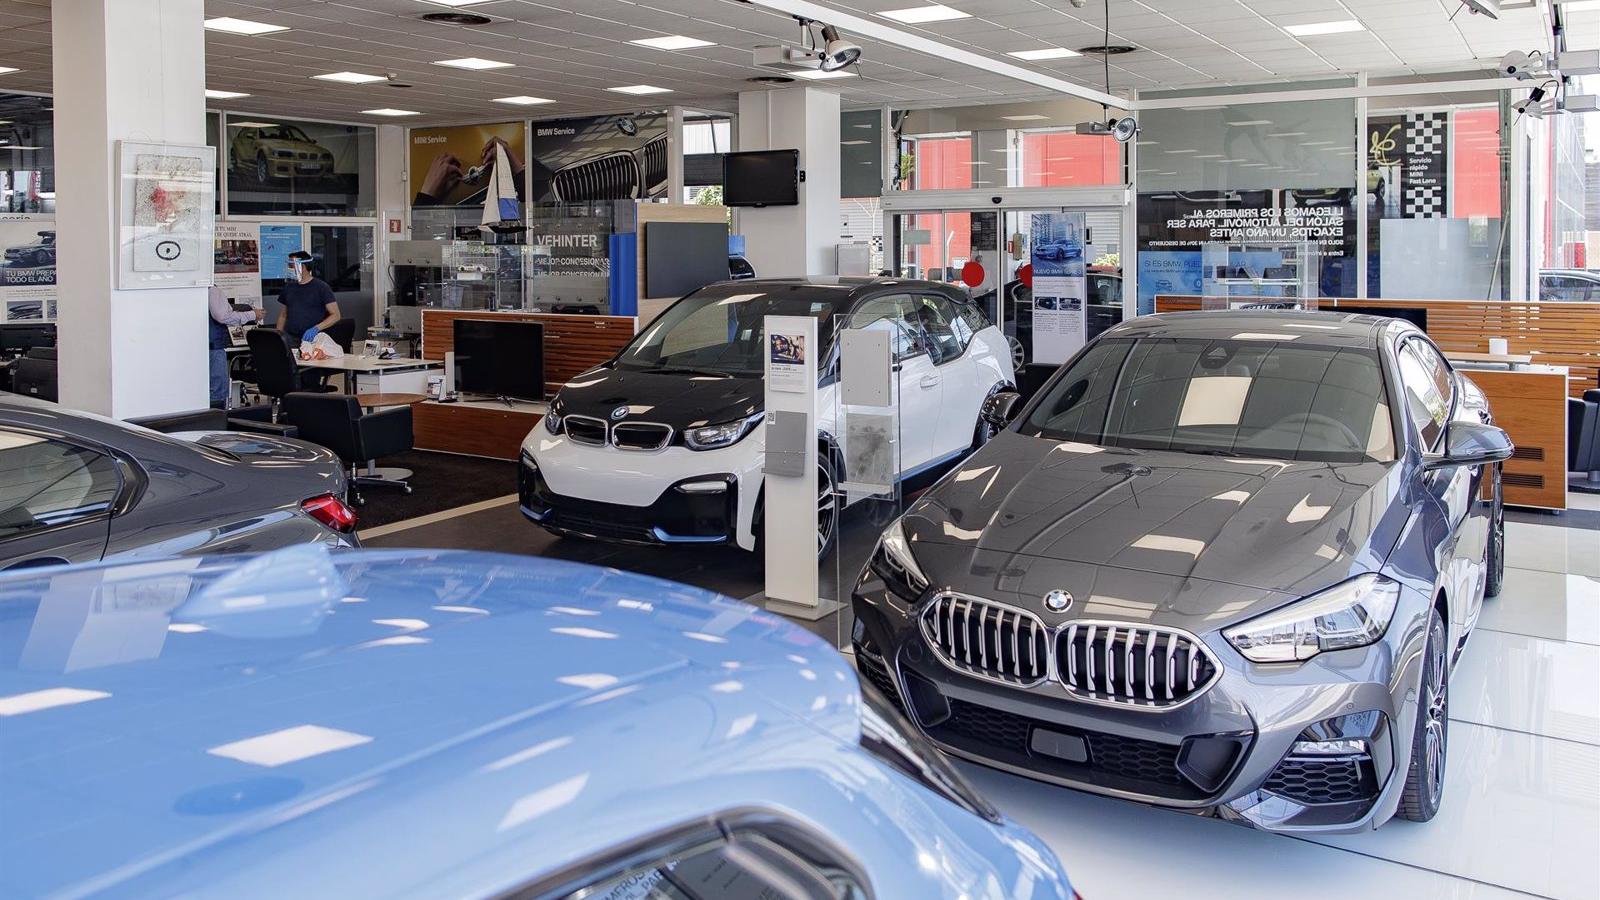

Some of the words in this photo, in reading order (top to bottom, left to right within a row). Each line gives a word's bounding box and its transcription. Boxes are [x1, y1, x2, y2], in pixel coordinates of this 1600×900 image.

[537, 128, 553, 136] BMW
[553, 127, 575, 135] Service
[427, 135, 447, 144] Service
[537, 234, 598, 247] VEHINTER
